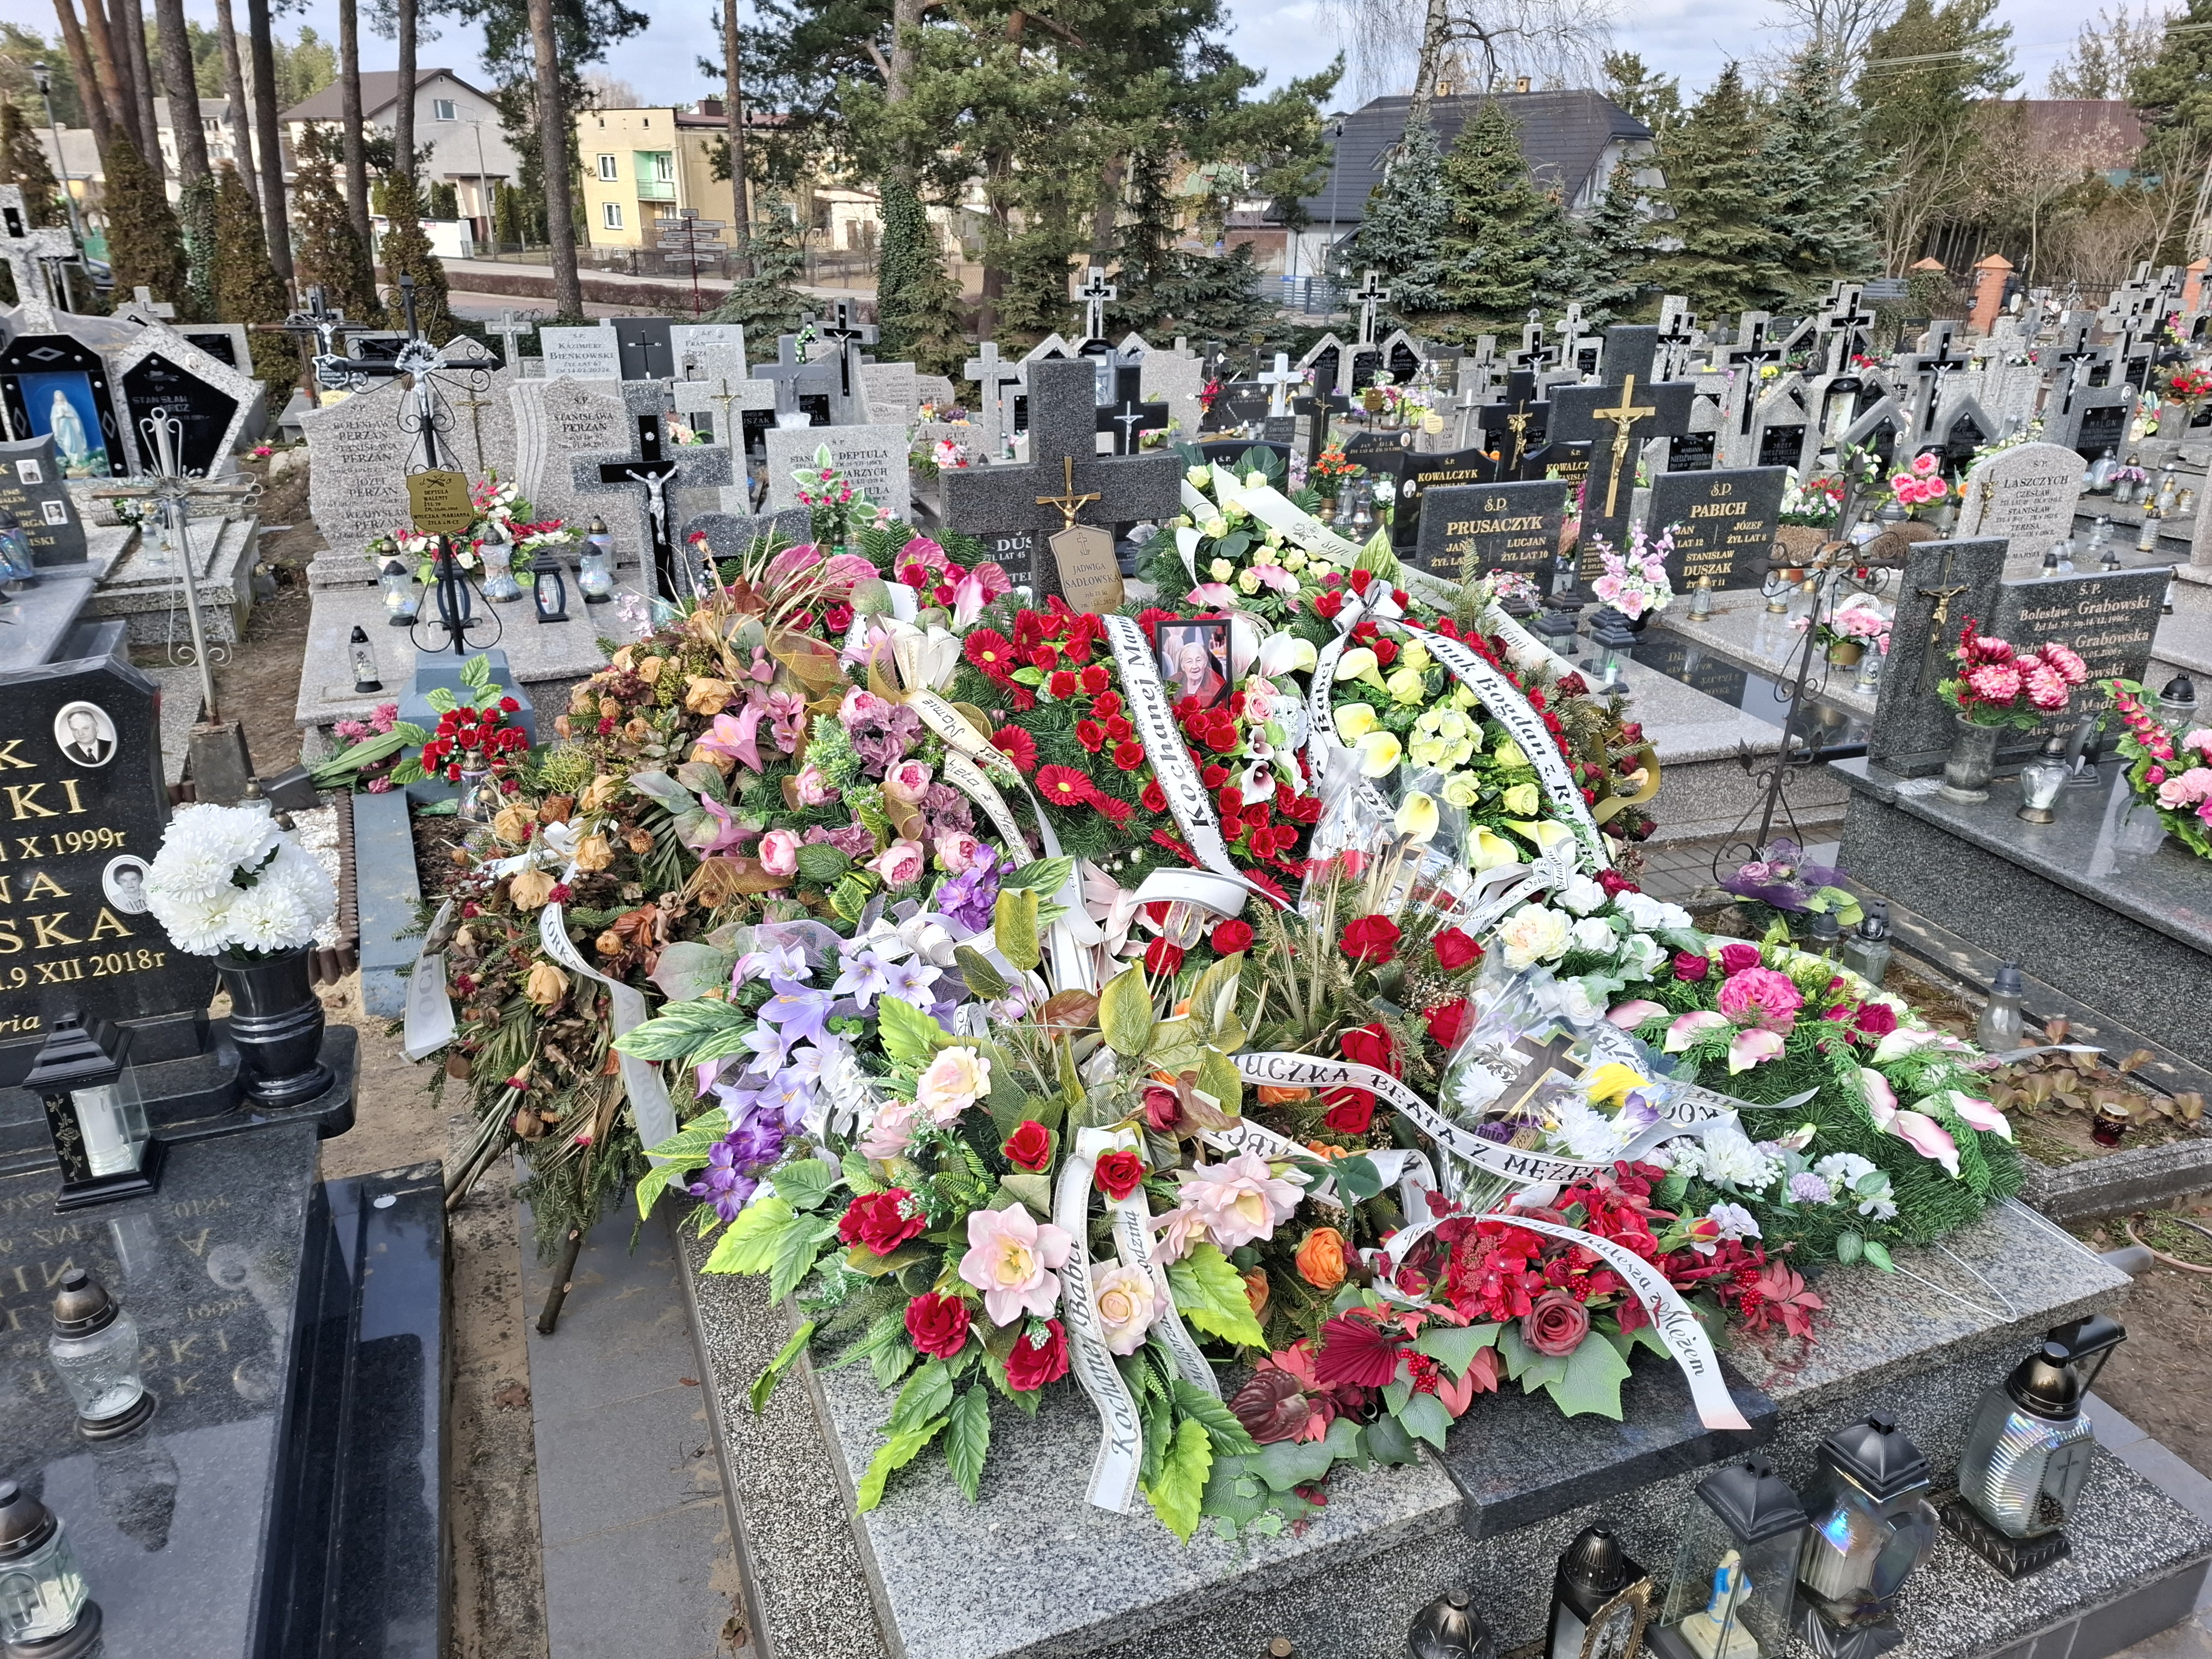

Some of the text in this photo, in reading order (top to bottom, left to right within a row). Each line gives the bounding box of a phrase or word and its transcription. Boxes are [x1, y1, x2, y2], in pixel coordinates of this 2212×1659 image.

[1418, 469, 1478, 482] KOWALCZYK
[1484, 496, 1507, 511] Ś.P.
[1690, 501, 1748, 518] PABICH
[1446, 516, 1543, 536] PRUSACZYK
[1675, 525, 1695, 536] JAN
[1733, 520, 1763, 531] JÓZEF
[1507, 537, 1546, 548] LUCJAN
[1695, 538, 1703, 546] 12
[1727, 534, 1743, 544] ŻYŁ
[1745, 534, 1761, 542] LAT
[999, 551, 1026, 561] LAT 45
[1500, 550, 1548, 562] ŻYŁ LAT 10
[1686, 550, 1735, 562] STANISŁAW
[1072, 562, 1107, 576] JADWIGA
[1683, 562, 1733, 577] DUSZAK
[1064, 574, 1121, 589] SADŁOWSKA
[2020, 595, 2151, 622] Bolesław Grabowski
[2075, 628, 2150, 648] Grabowska
[922, 699, 965, 738] Mamie
[1476, 676, 1548, 757] Bogdan
[1134, 678, 1210, 829] Kochanej
[3, 779, 88, 820] KI
[15, 827, 127, 859] X 1999r
[0, 906, 136, 954] SKA
[544, 910, 581, 972] CÓRKA
[33, 949, 166, 985] XII 2018r
[1368, 1073, 1456, 1147] BEATA
[1469, 1142, 1488, 1163] Z
[1657, 1301, 1706, 1377] Mężem
